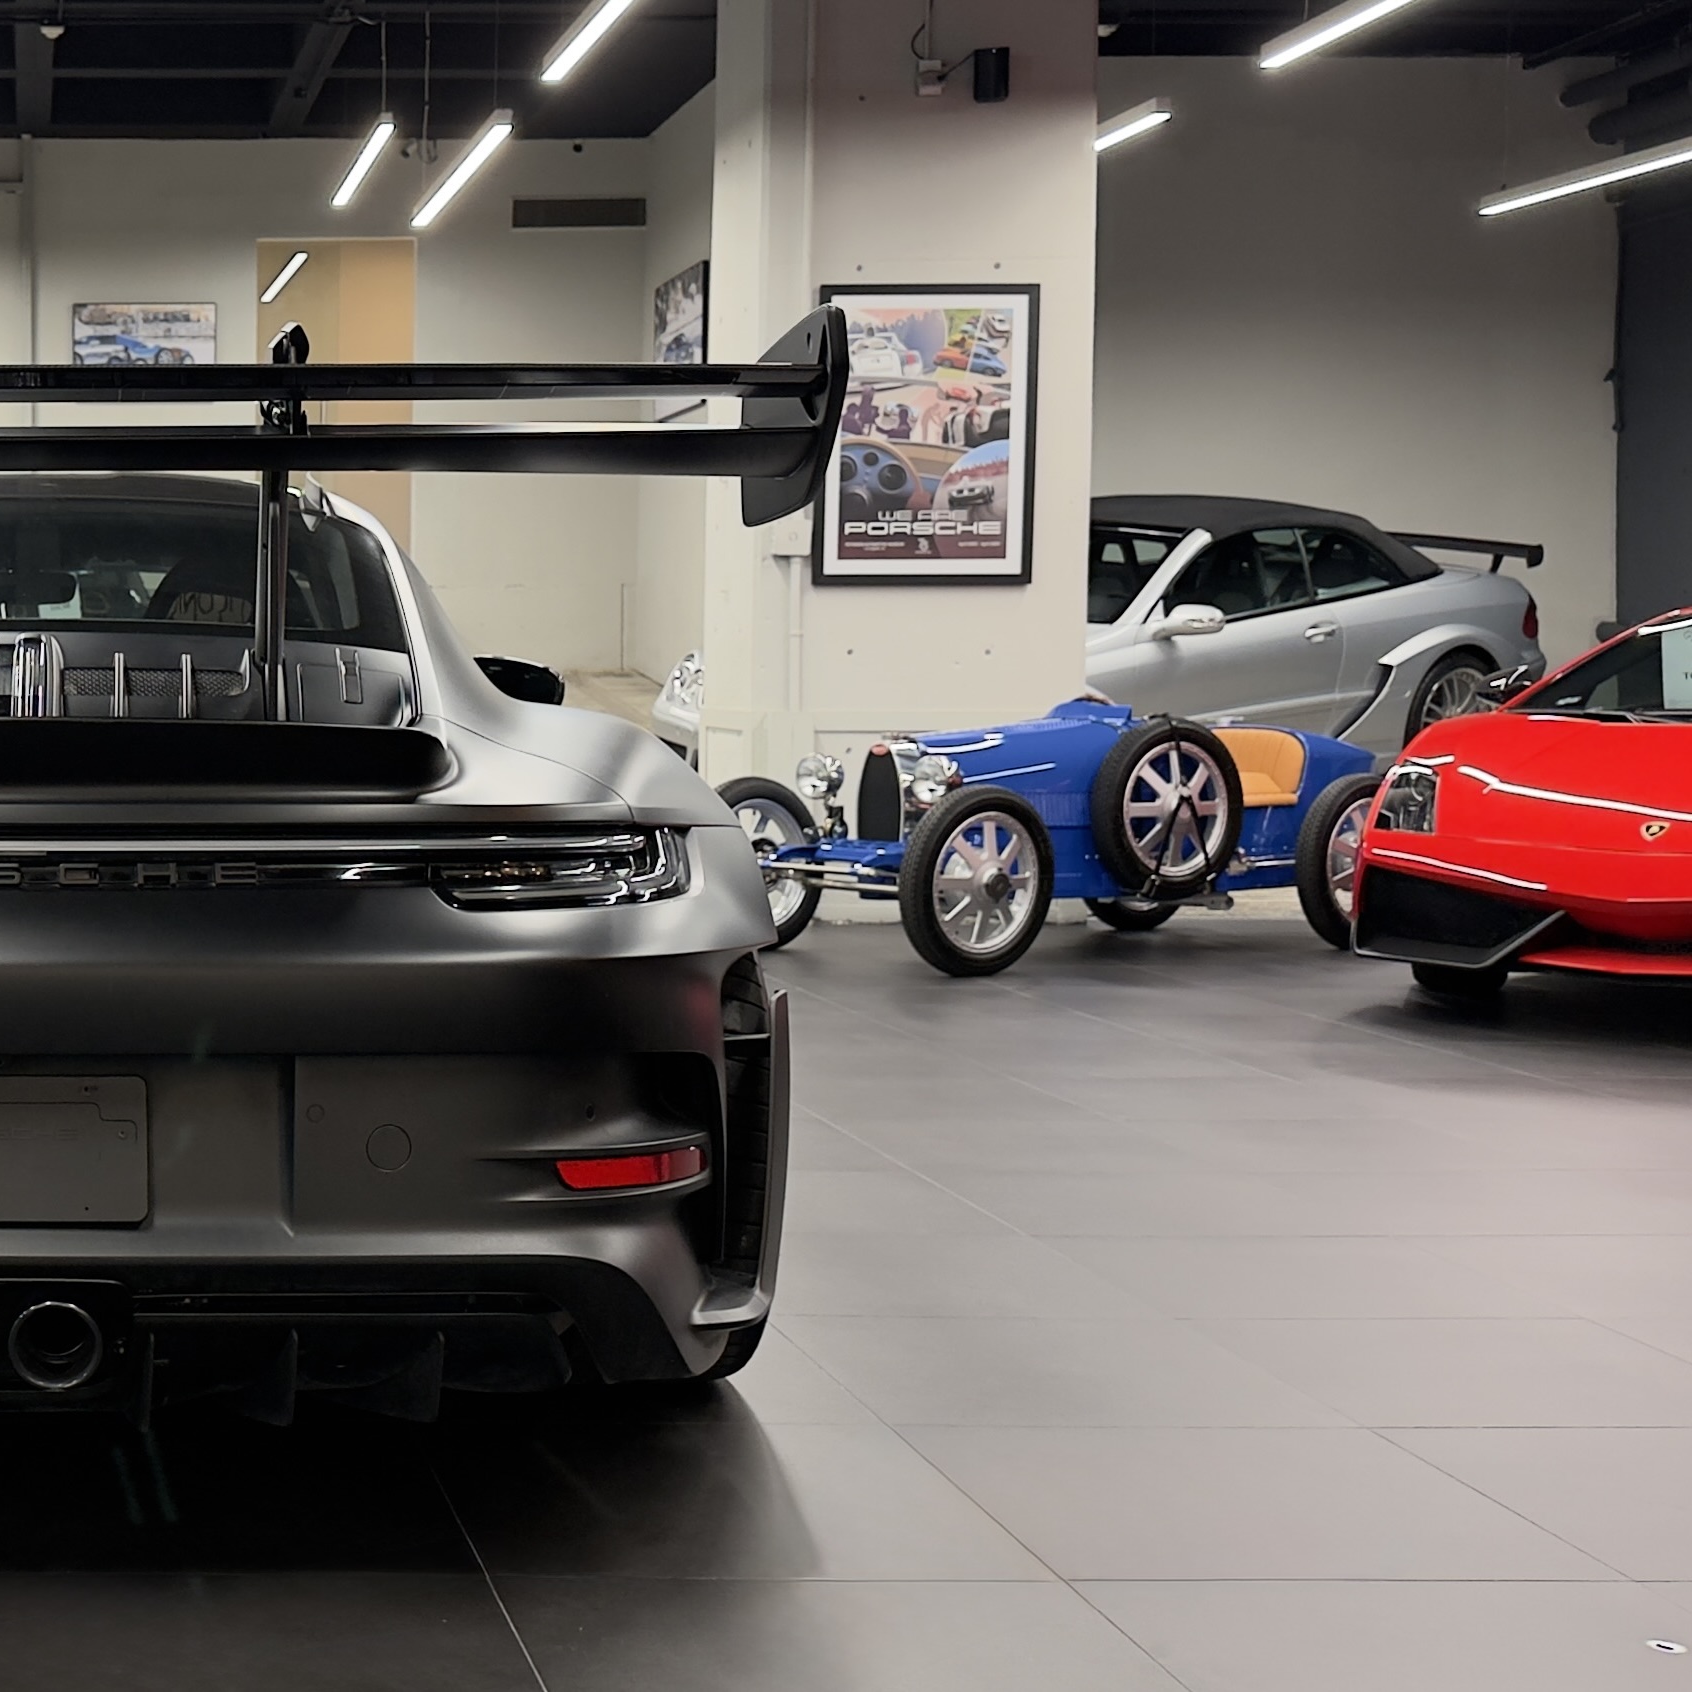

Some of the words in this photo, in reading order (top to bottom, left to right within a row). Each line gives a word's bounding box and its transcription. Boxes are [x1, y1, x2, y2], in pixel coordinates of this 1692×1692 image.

[877, 510, 913, 521] WE
[917, 510, 968, 521] ARE
[844, 521, 1002, 536] PORSCHE
